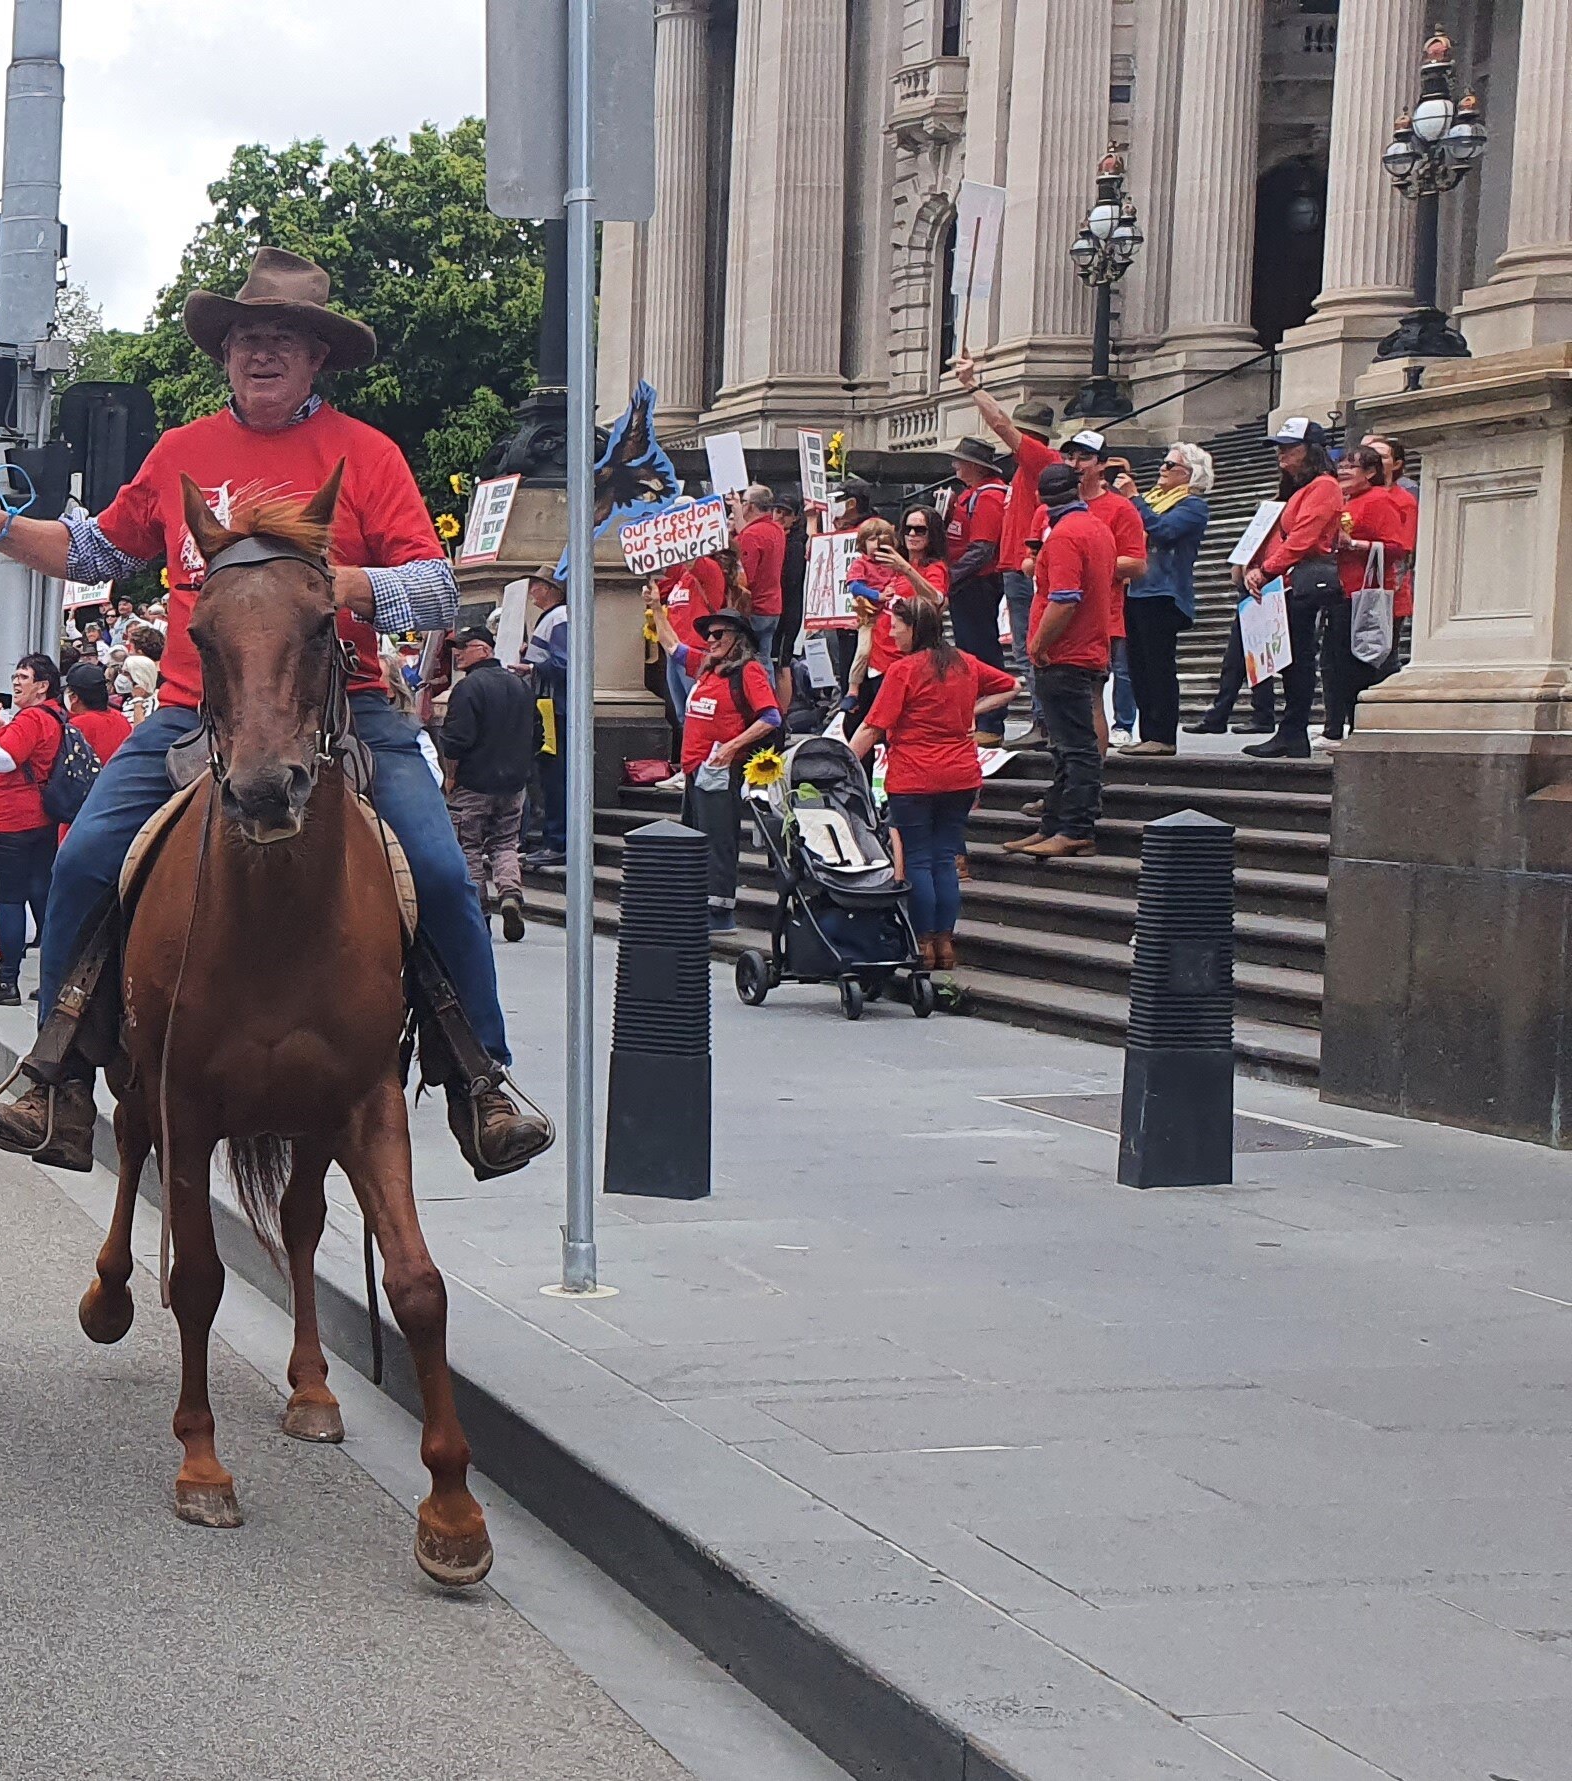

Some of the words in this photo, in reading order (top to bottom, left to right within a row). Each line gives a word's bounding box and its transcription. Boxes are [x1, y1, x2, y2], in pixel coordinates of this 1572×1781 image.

[623, 520, 650, 539] our
[654, 502, 721, 532] freedom
[623, 536, 650, 555] our
